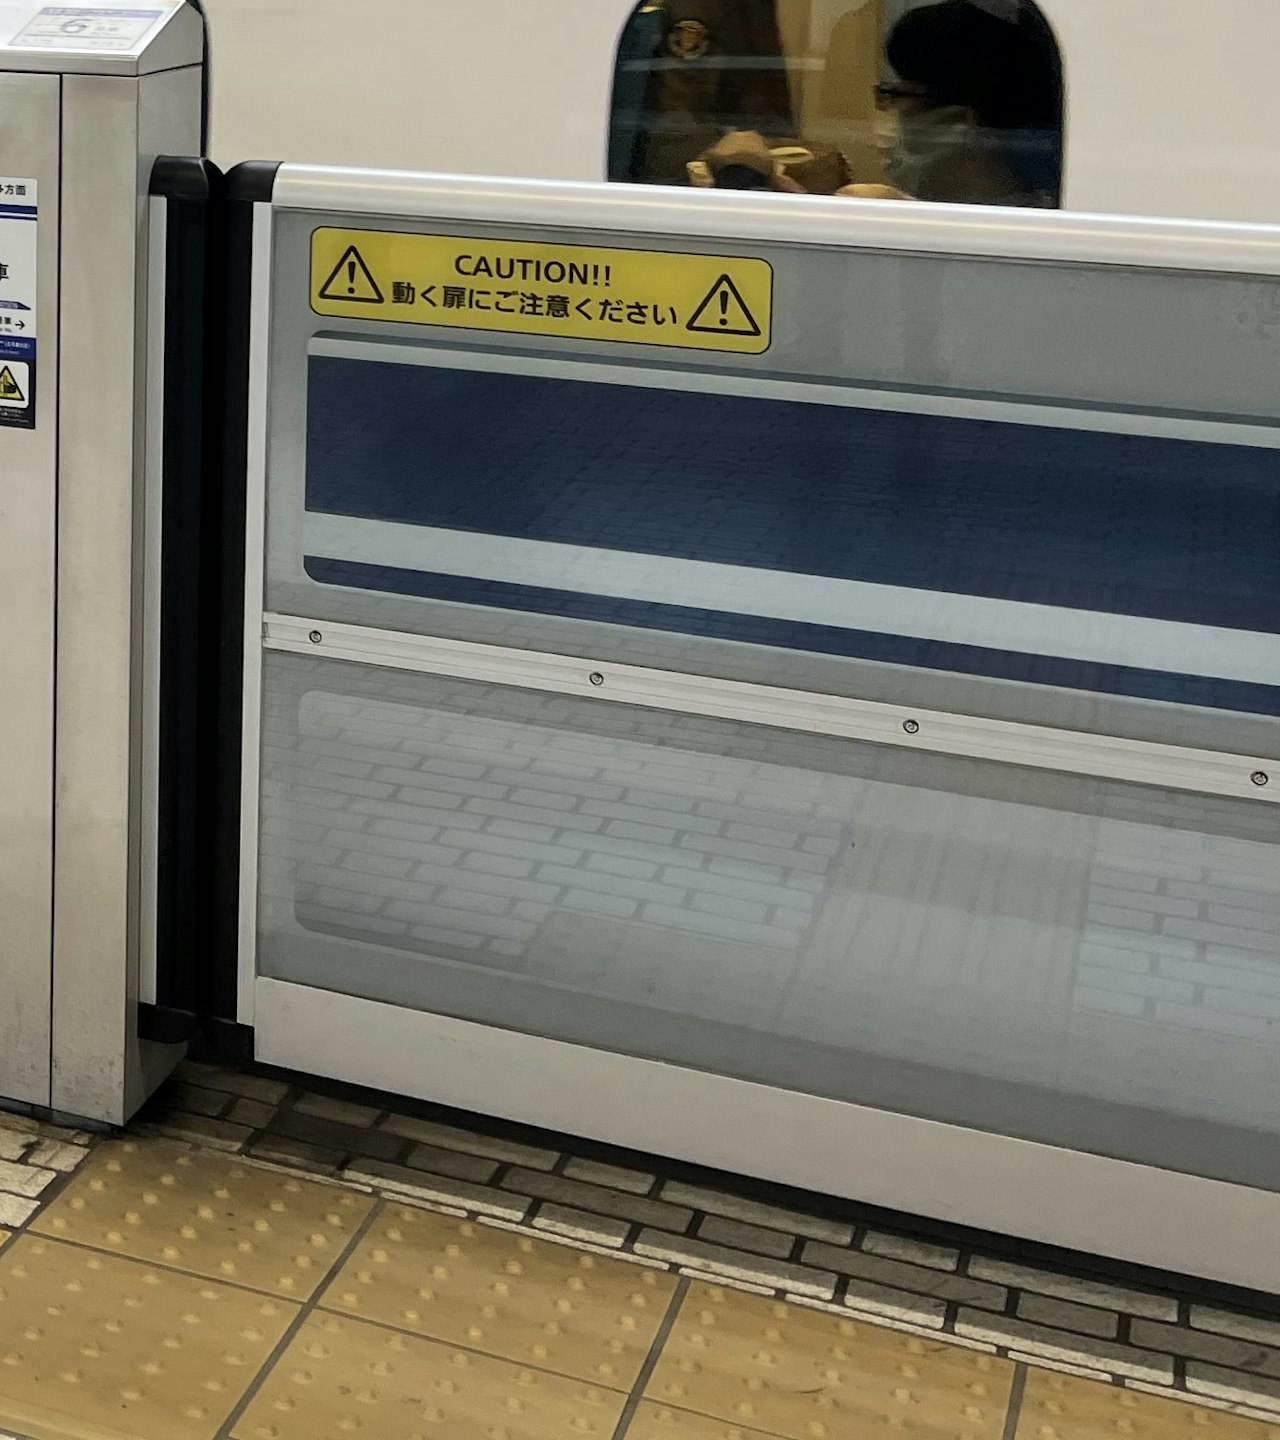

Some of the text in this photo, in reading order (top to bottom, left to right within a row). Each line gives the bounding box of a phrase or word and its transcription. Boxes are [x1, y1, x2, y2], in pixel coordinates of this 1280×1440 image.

[454, 254, 612, 287] CAUTION!!
[391, 281, 676, 327] 動く扉にご注意ください
